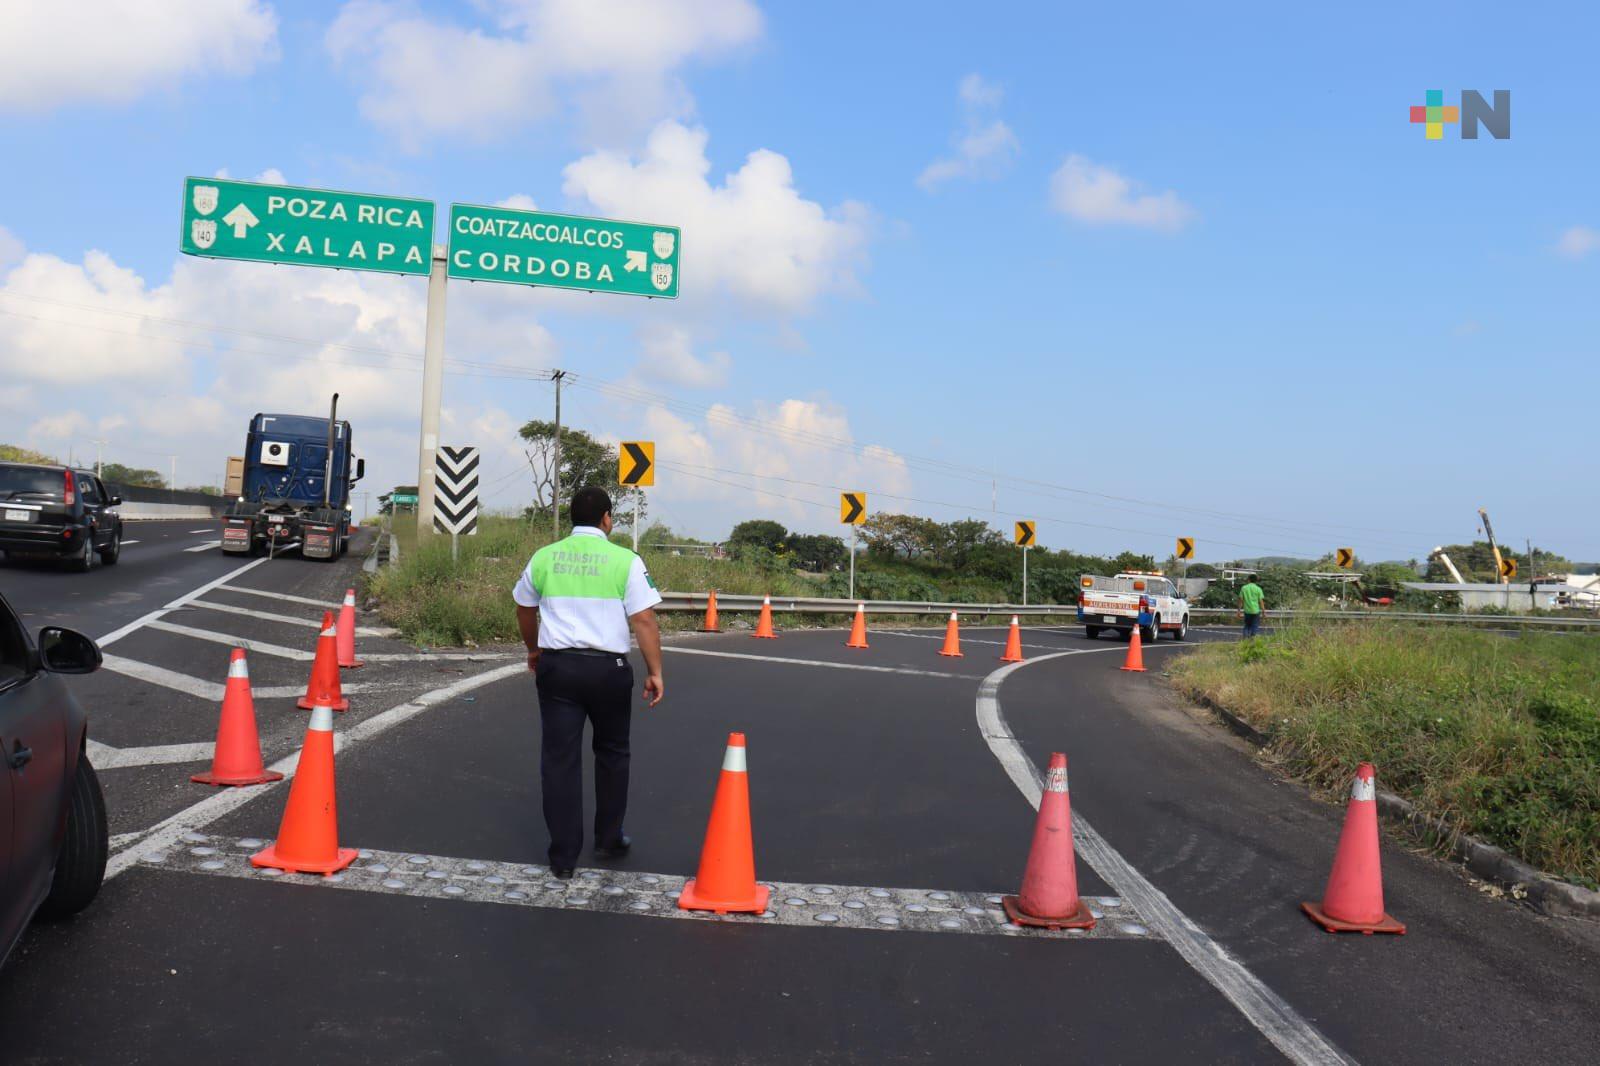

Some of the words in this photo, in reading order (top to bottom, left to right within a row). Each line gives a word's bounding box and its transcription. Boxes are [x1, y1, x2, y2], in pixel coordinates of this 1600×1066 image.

[267, 196, 348, 222] POZA
[357, 204, 424, 229] RICA
[197, 231, 211, 242] 140
[266, 232, 423, 264] XALAPA
[455, 215, 624, 249] COATZACOALCOS
[454, 249, 614, 283] CORDOBA
[656, 274, 668, 285] 150
[553, 562, 601, 577] ESTATAL
